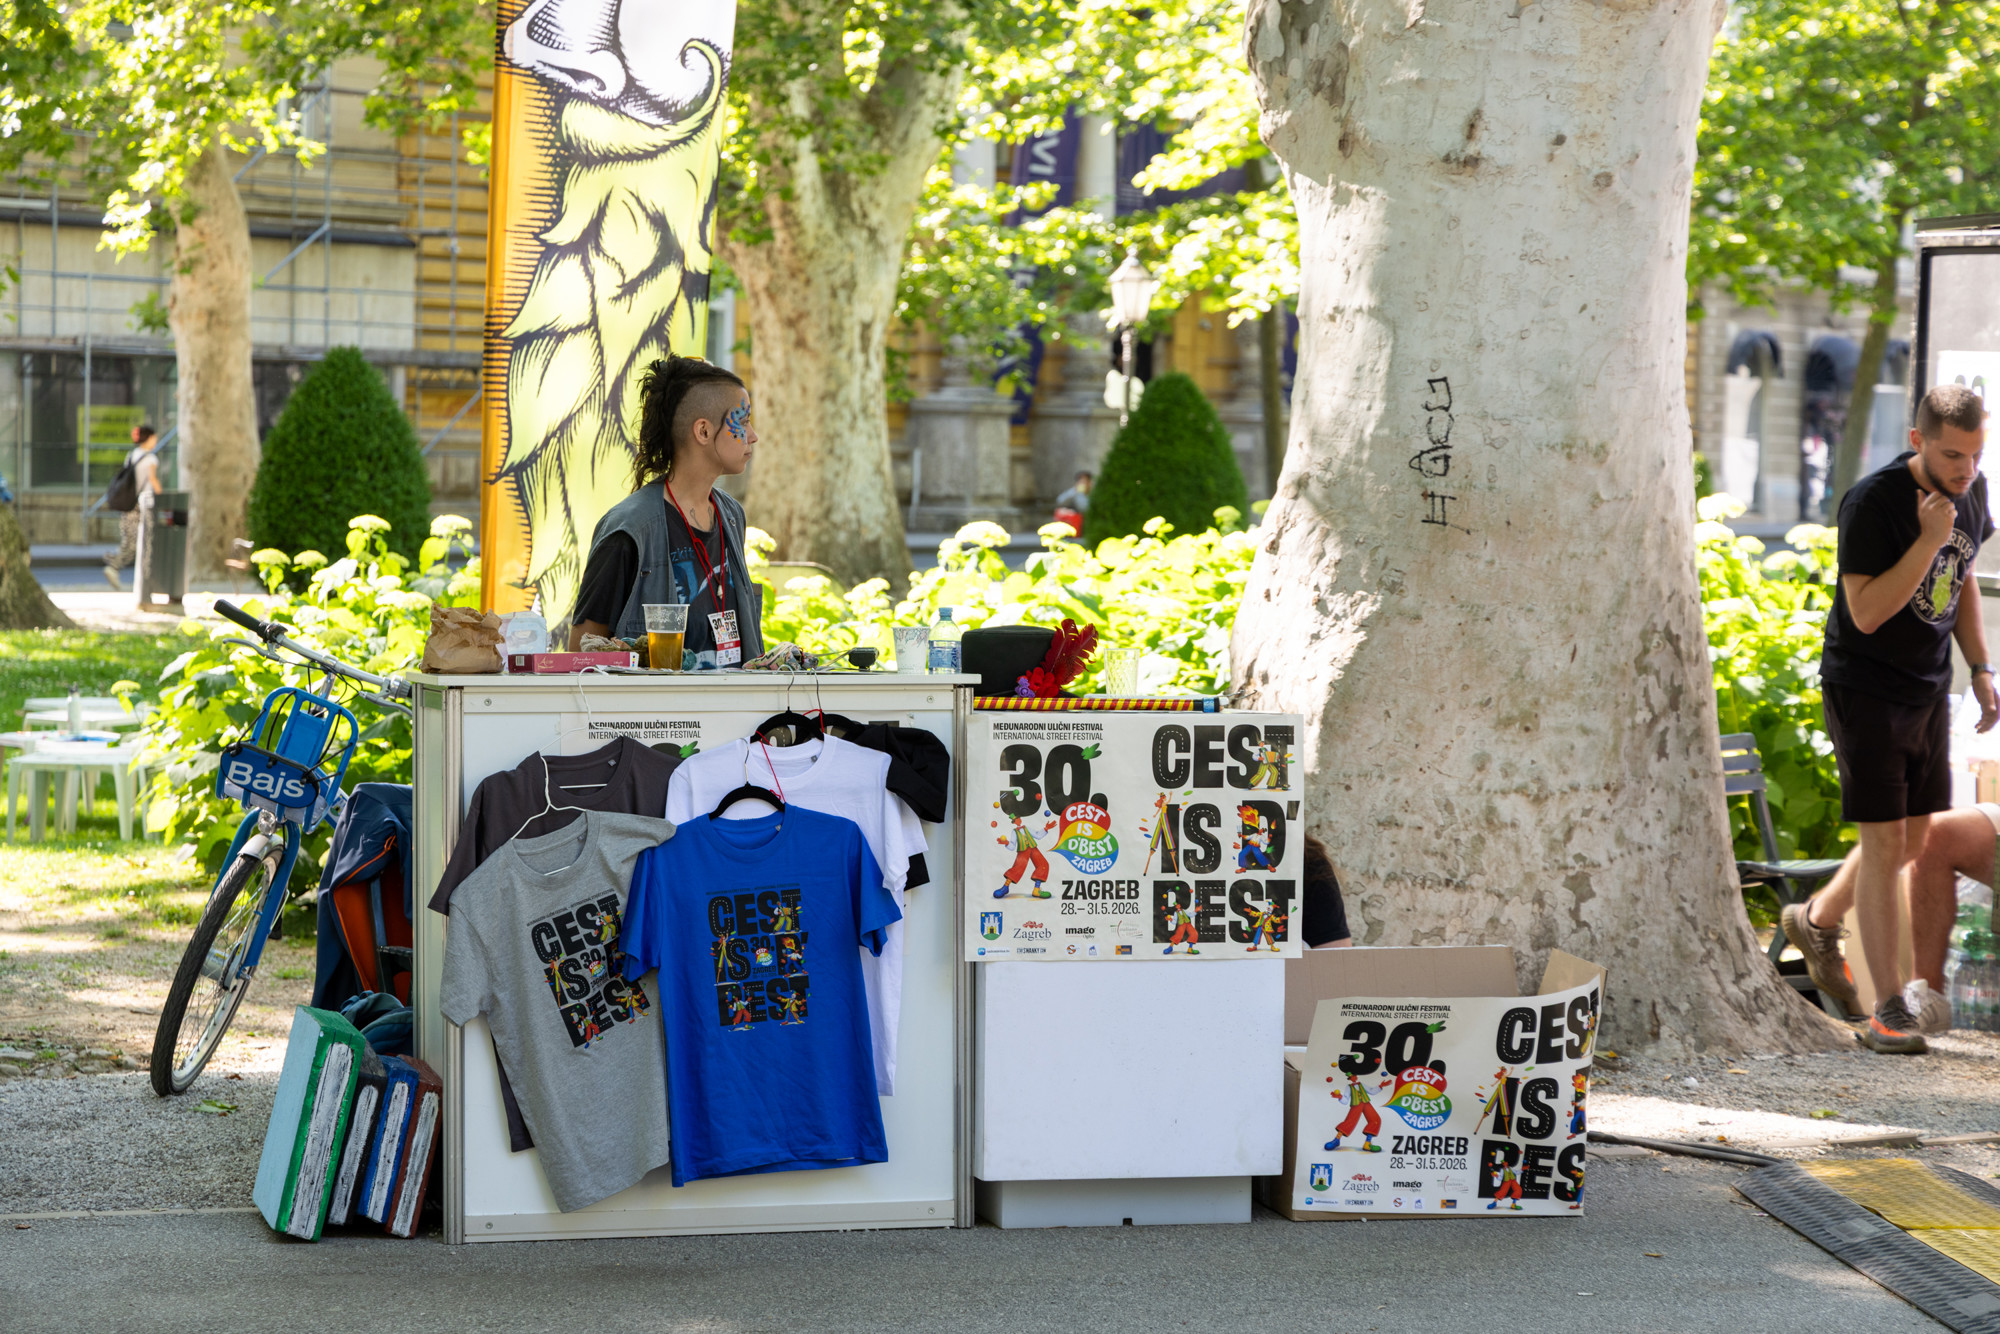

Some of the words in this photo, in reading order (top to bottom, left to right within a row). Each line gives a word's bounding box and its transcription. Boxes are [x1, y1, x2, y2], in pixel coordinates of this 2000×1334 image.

[670, 546, 694, 562] zkit
[644, 719, 668, 729] ULIČNI
[669, 721, 701, 729] FESTIVAL
[993, 722, 1046, 731] MEĐUNARODNI
[1047, 721, 1070, 731] ULIČNI
[1072, 723, 1103, 731] FESTIVAL
[643, 730, 669, 739] STREET
[670, 730, 701, 738] FESTIVAL
[993, 732, 1045, 740] INTERNATIONAL
[1046, 732, 1071, 740] STREET
[1073, 732, 1103, 740] FESTIVAL
[1152, 724, 1294, 789] CEST
[227, 760, 305, 799] Bajs
[999, 744, 1108, 817] 30.
[1066, 804, 1106, 822] CEST
[1076, 822, 1093, 836] IS
[1161, 802, 1222, 875] IS
[1068, 835, 1113, 856] D'BEST
[1071, 855, 1113, 873] ZAGREB
[1061, 880, 1140, 900] ZAGREB
[708, 888, 802, 939] CEST
[1153, 878, 1296, 943] BEST
[531, 893, 622, 964] CEST
[1013, 928, 1052, 941] Zagreb
[1065, 926, 1095, 935] imago
[749, 935, 775, 954] 30.
[580, 948, 606, 970] 30.
[712, 938, 751, 983] IS
[544, 957, 591, 1008] IS
[716, 975, 810, 1027] BEST
[1341, 1003, 1395, 1011] MEĐUNARODNI
[1396, 1003, 1419, 1011] ULIČNI
[1338, 1020, 1446, 1077] 30.
[1402, 1068, 1443, 1085] CEST
[1411, 1083, 1428, 1096] IS
[1401, 1096, 1447, 1114] D'BEST
[1491, 1077, 1559, 1140] IS
[1403, 1112, 1445, 1129] ZAGREB
[1391, 1135, 1469, 1156] ZAGREB
[1477, 1139, 1586, 1202] BES
[1342, 1180, 1380, 1194] Zagreb
